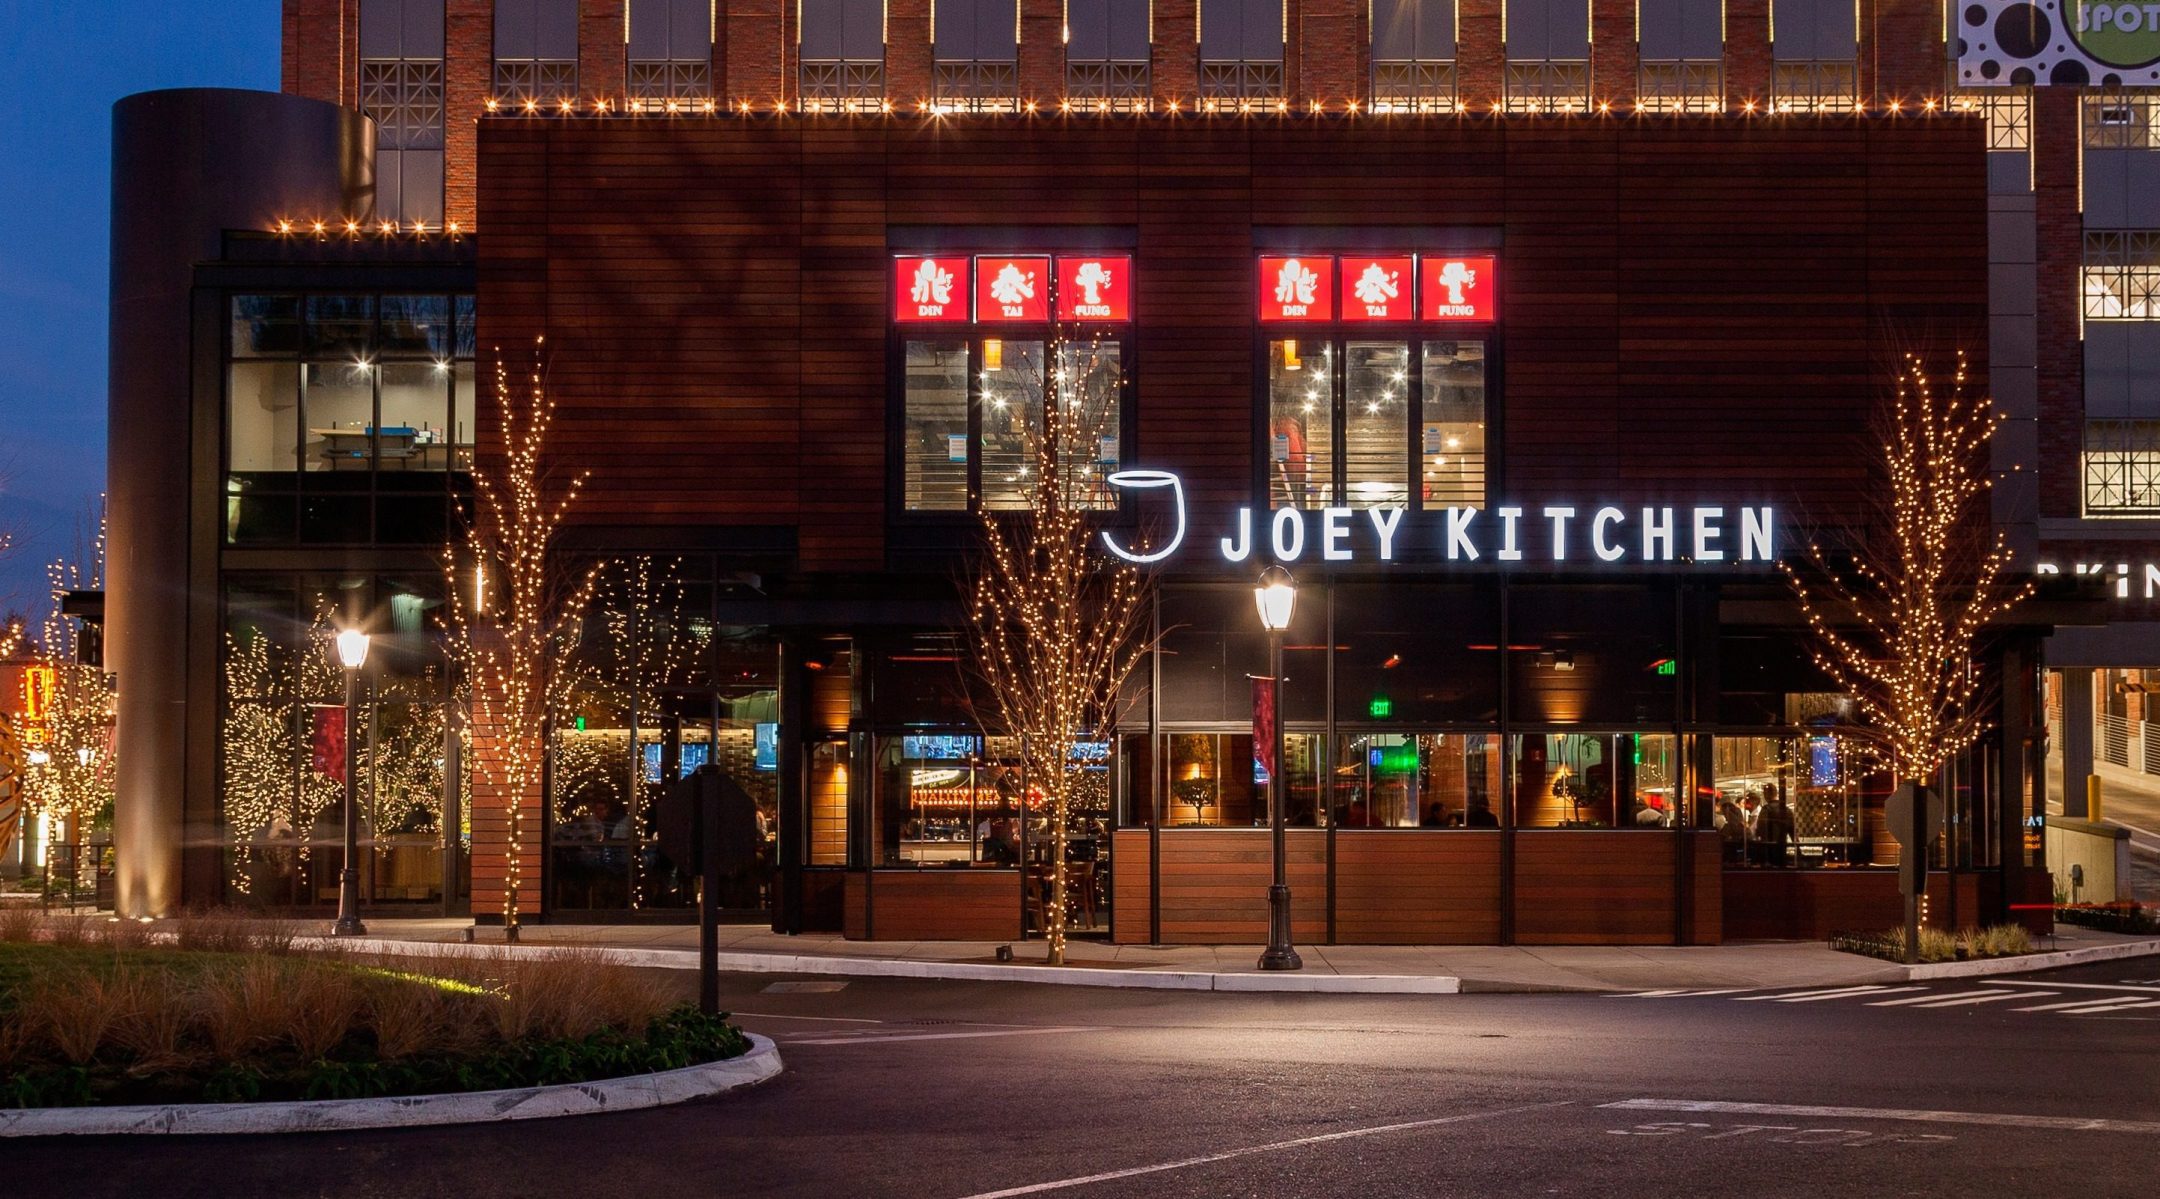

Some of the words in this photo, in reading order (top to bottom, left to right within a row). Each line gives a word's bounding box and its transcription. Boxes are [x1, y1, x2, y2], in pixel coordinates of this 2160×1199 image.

[918, 305, 943, 316] DIN
[1002, 305, 1023, 317] TAI
[1075, 305, 1110, 316] FUNG
[1282, 305, 1307, 316] DIN
[1365, 305, 1387, 317] TAI
[1439, 305, 1475, 316] FUNG
[1221, 507, 1404, 562] JOEY
[1447, 506, 1773, 562] KITCHEN
[1373, 702, 1389, 715] EXIT
